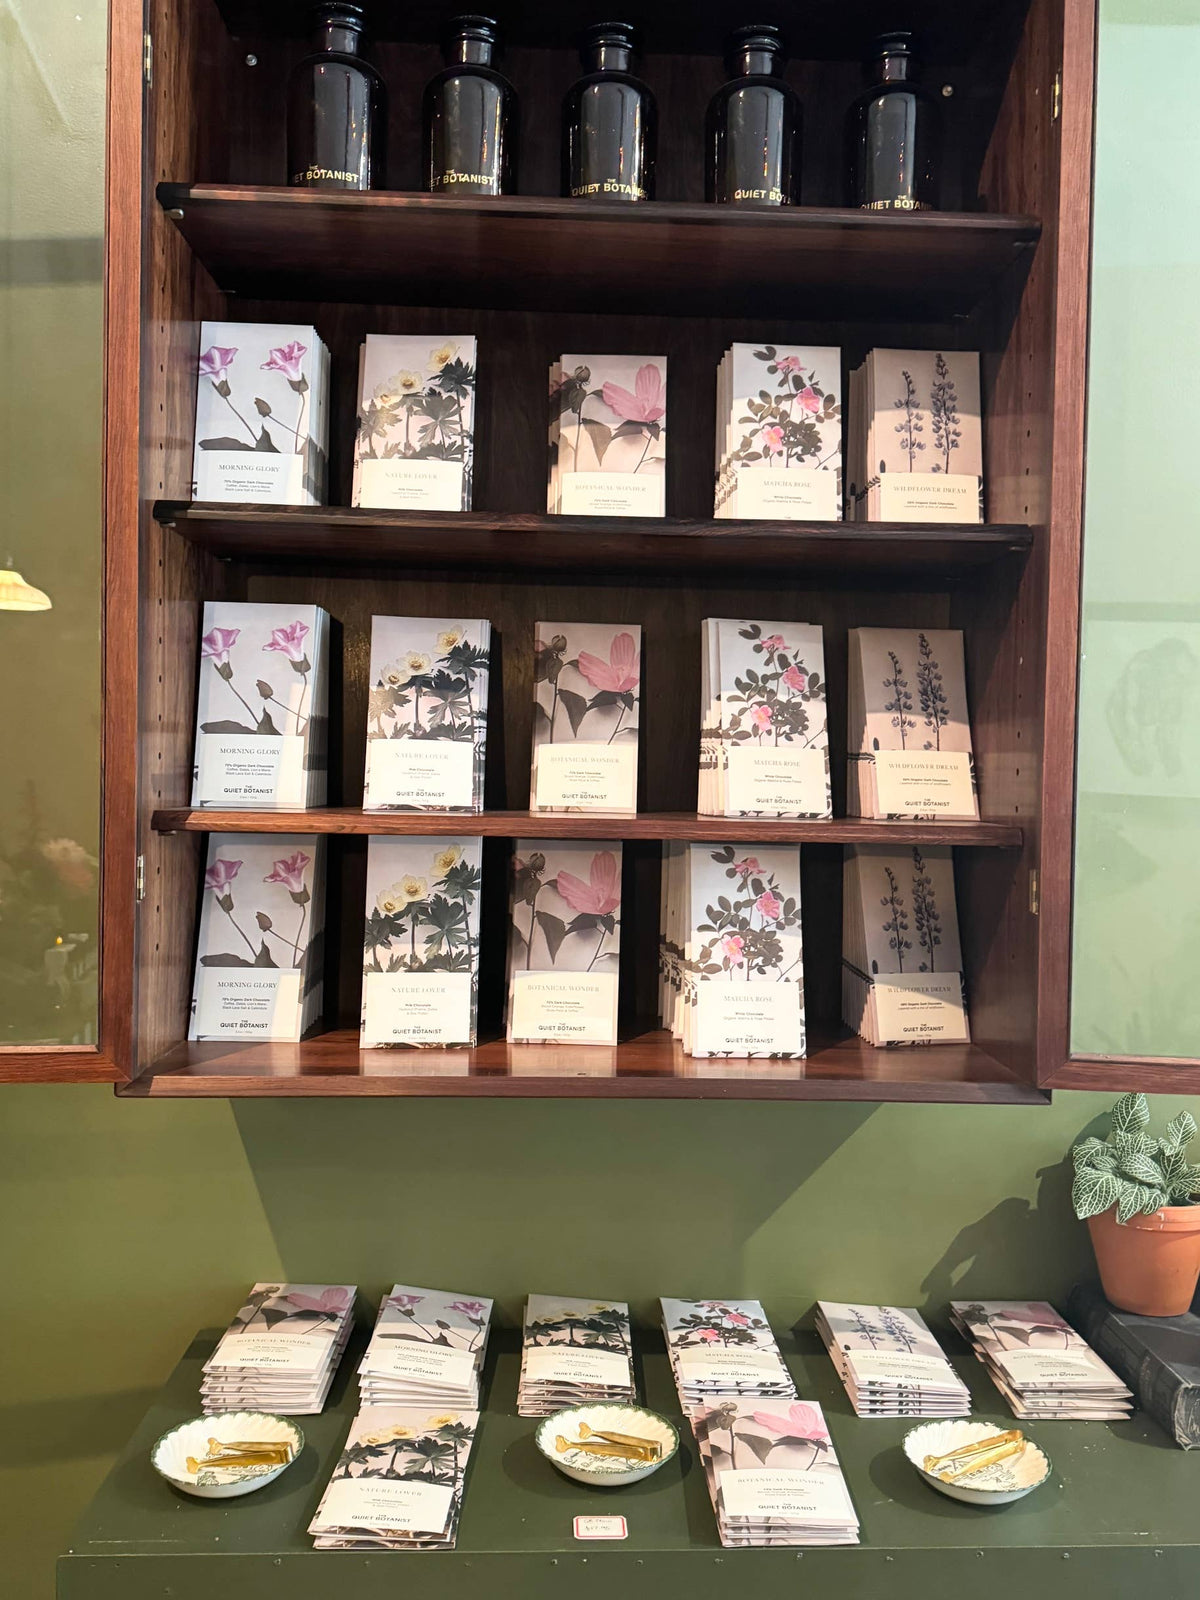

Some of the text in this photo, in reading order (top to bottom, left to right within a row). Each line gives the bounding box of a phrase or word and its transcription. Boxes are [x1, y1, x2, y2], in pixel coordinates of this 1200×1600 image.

[306, 169, 359, 183] BOTANIST
[443, 173, 495, 186] BOTANIST
[572, 183, 601, 197] QUIET
[735, 190, 766, 199] QUIET
[256, 465, 280, 473] GLORY
